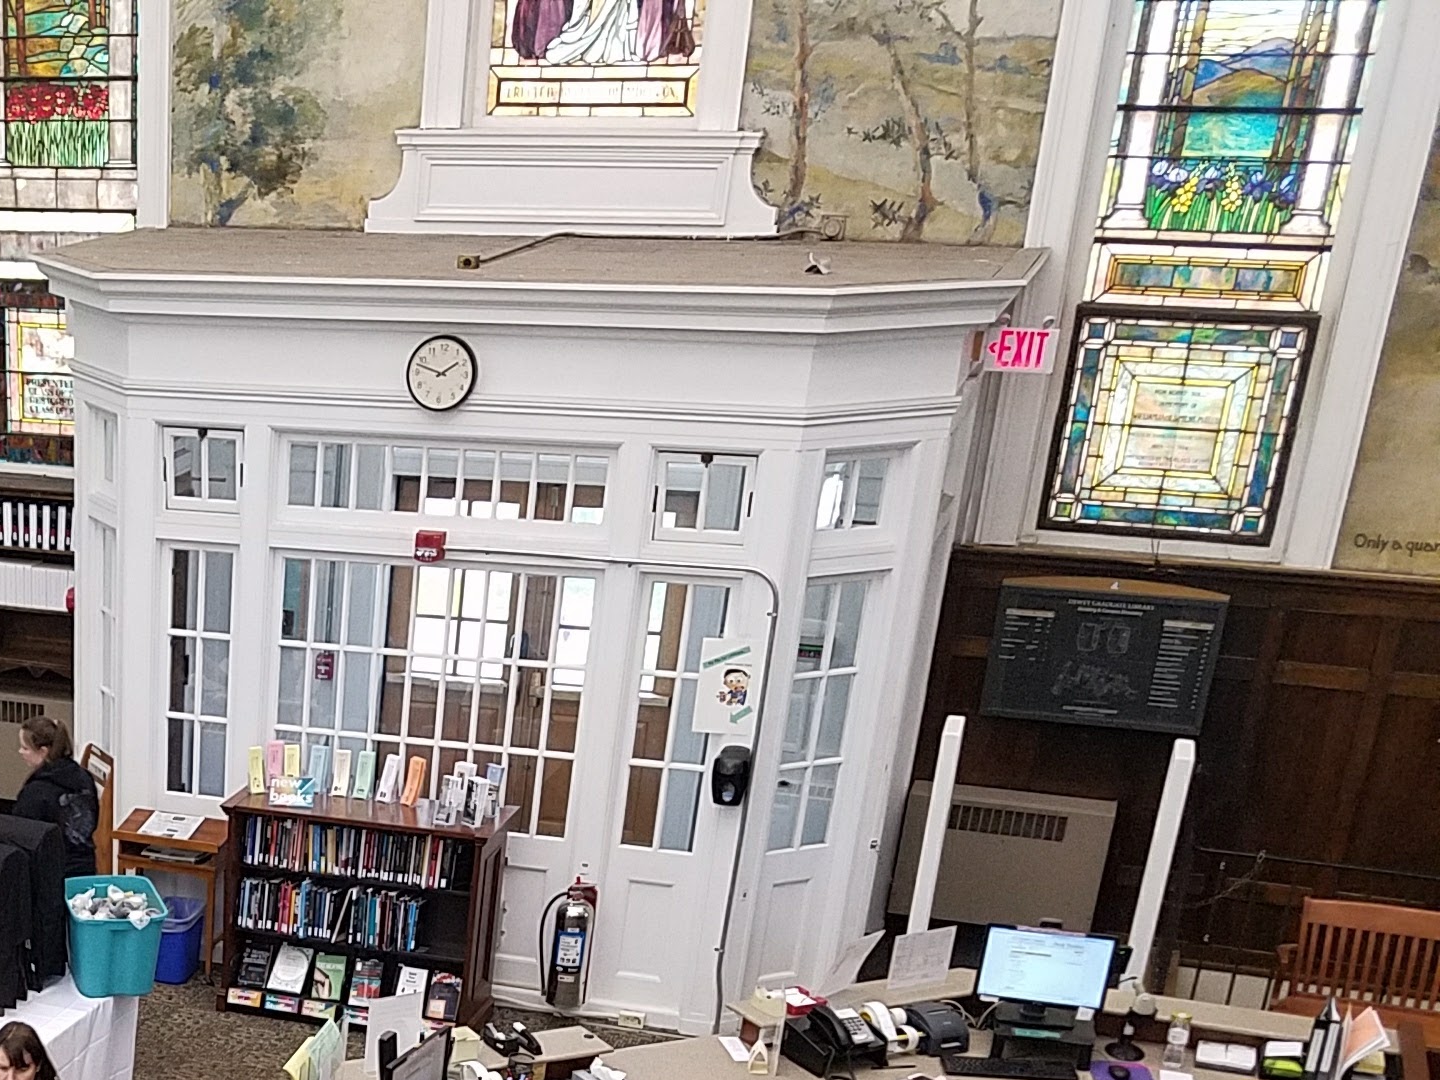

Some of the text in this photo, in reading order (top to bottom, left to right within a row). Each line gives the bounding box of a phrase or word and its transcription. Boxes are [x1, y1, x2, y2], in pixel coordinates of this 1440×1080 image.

[996, 330, 1050, 368] EXIT
[1354, 532, 1389, 554] Only
[1392, 540, 1403, 551] a
[271, 778, 303, 789] new
[269, 787, 313, 804] books
